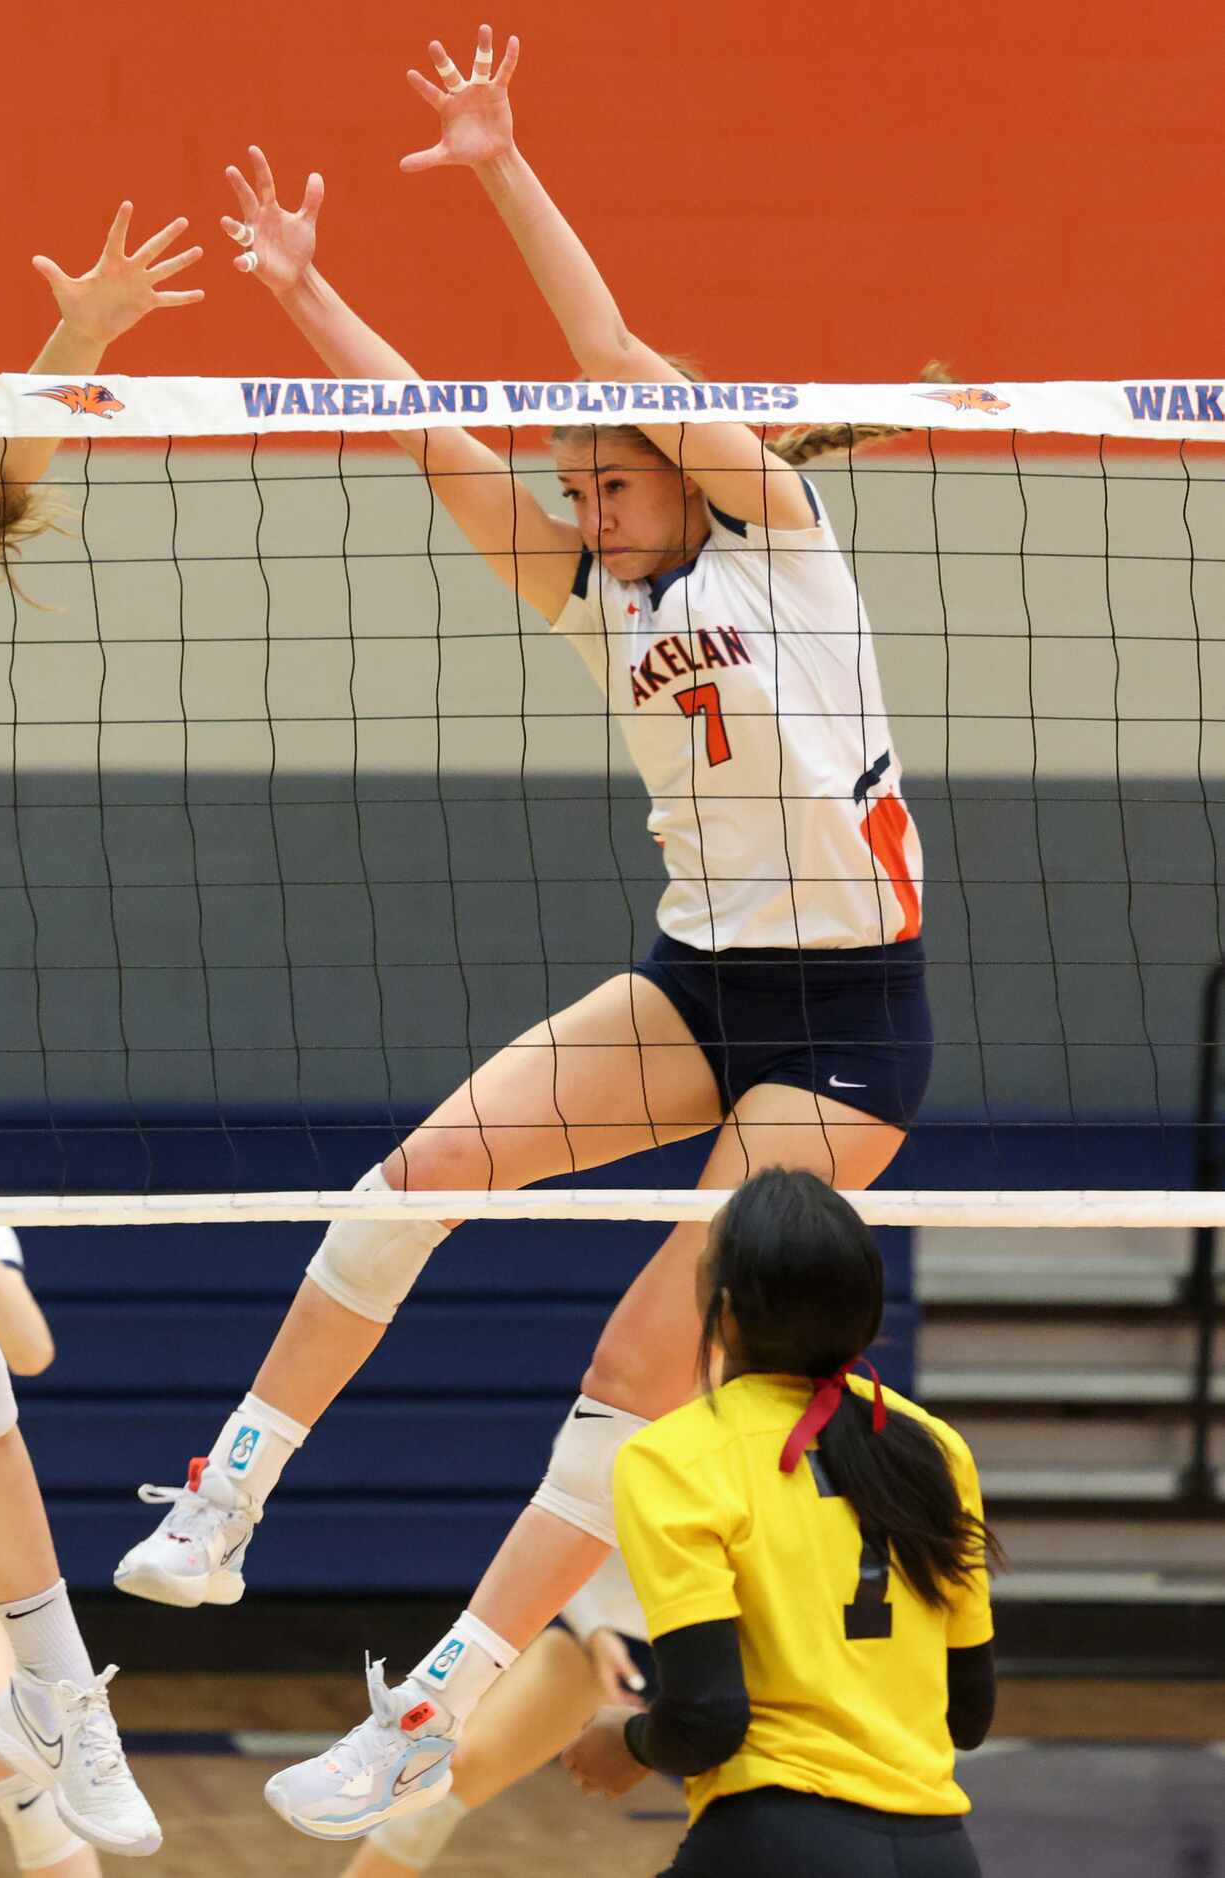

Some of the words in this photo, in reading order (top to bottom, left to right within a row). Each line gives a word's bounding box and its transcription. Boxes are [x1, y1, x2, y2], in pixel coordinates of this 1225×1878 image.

[240, 382, 488, 417] WAKELAND
[503, 384, 800, 413] WOLVERINES
[1123, 385, 1225, 421] WAK
[672, 681, 733, 768] 7
